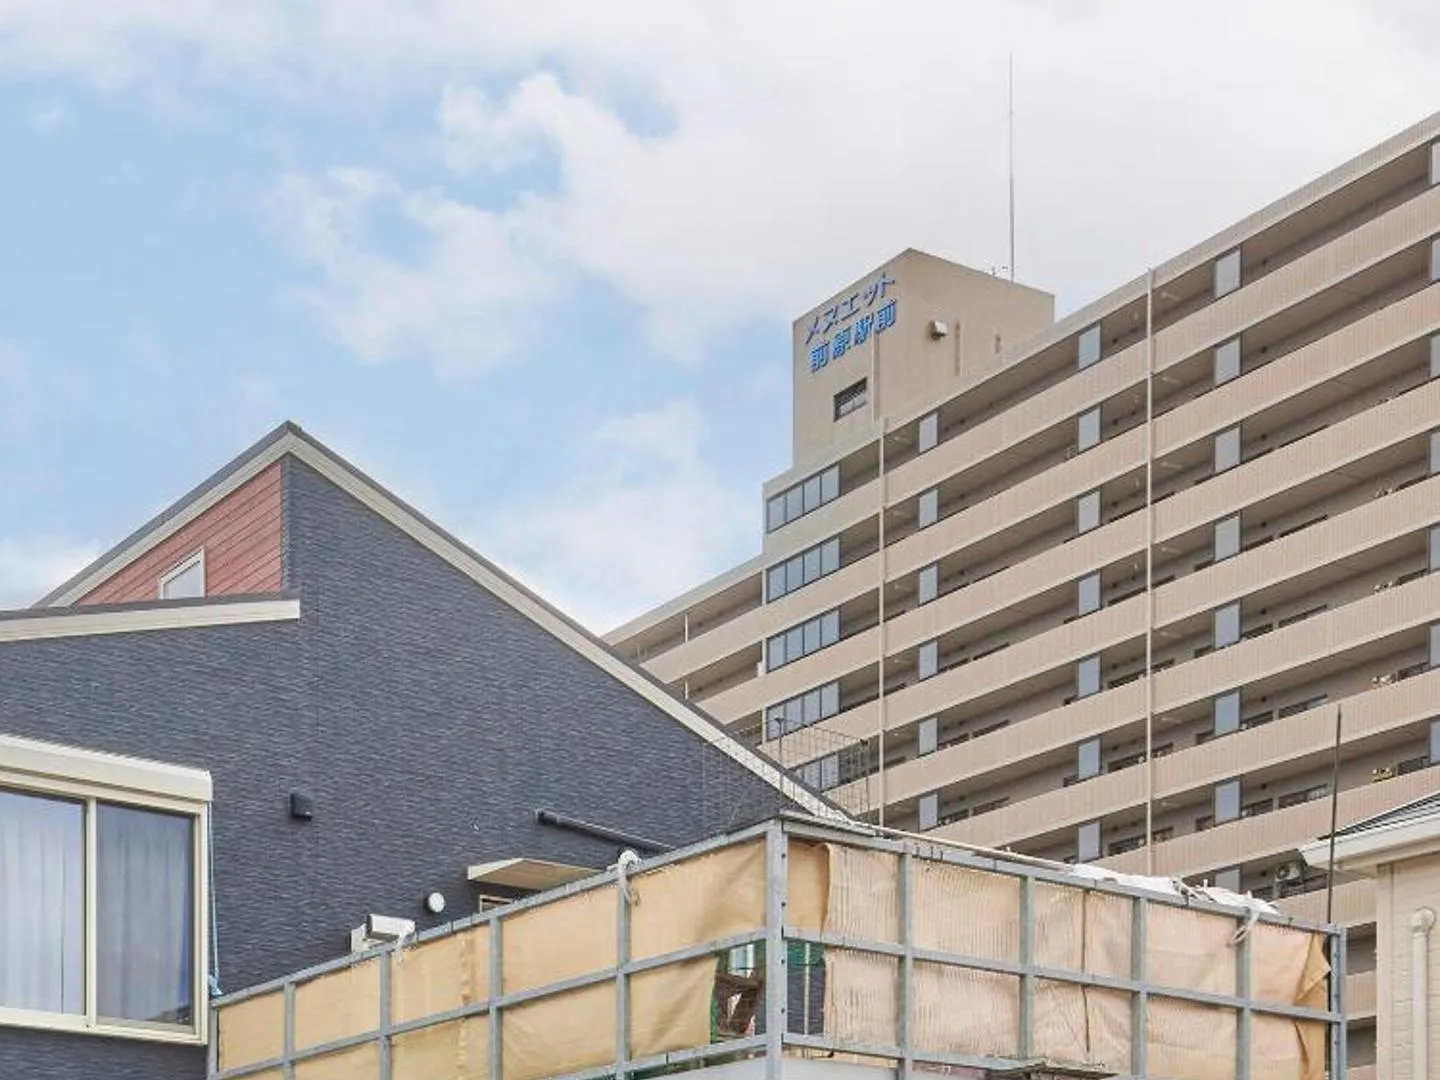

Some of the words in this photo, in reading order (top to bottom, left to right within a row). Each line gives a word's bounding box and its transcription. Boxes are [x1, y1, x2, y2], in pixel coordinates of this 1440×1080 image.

[804, 271, 897, 345] メヌエット
[810, 299, 898, 373] 前原駅前
